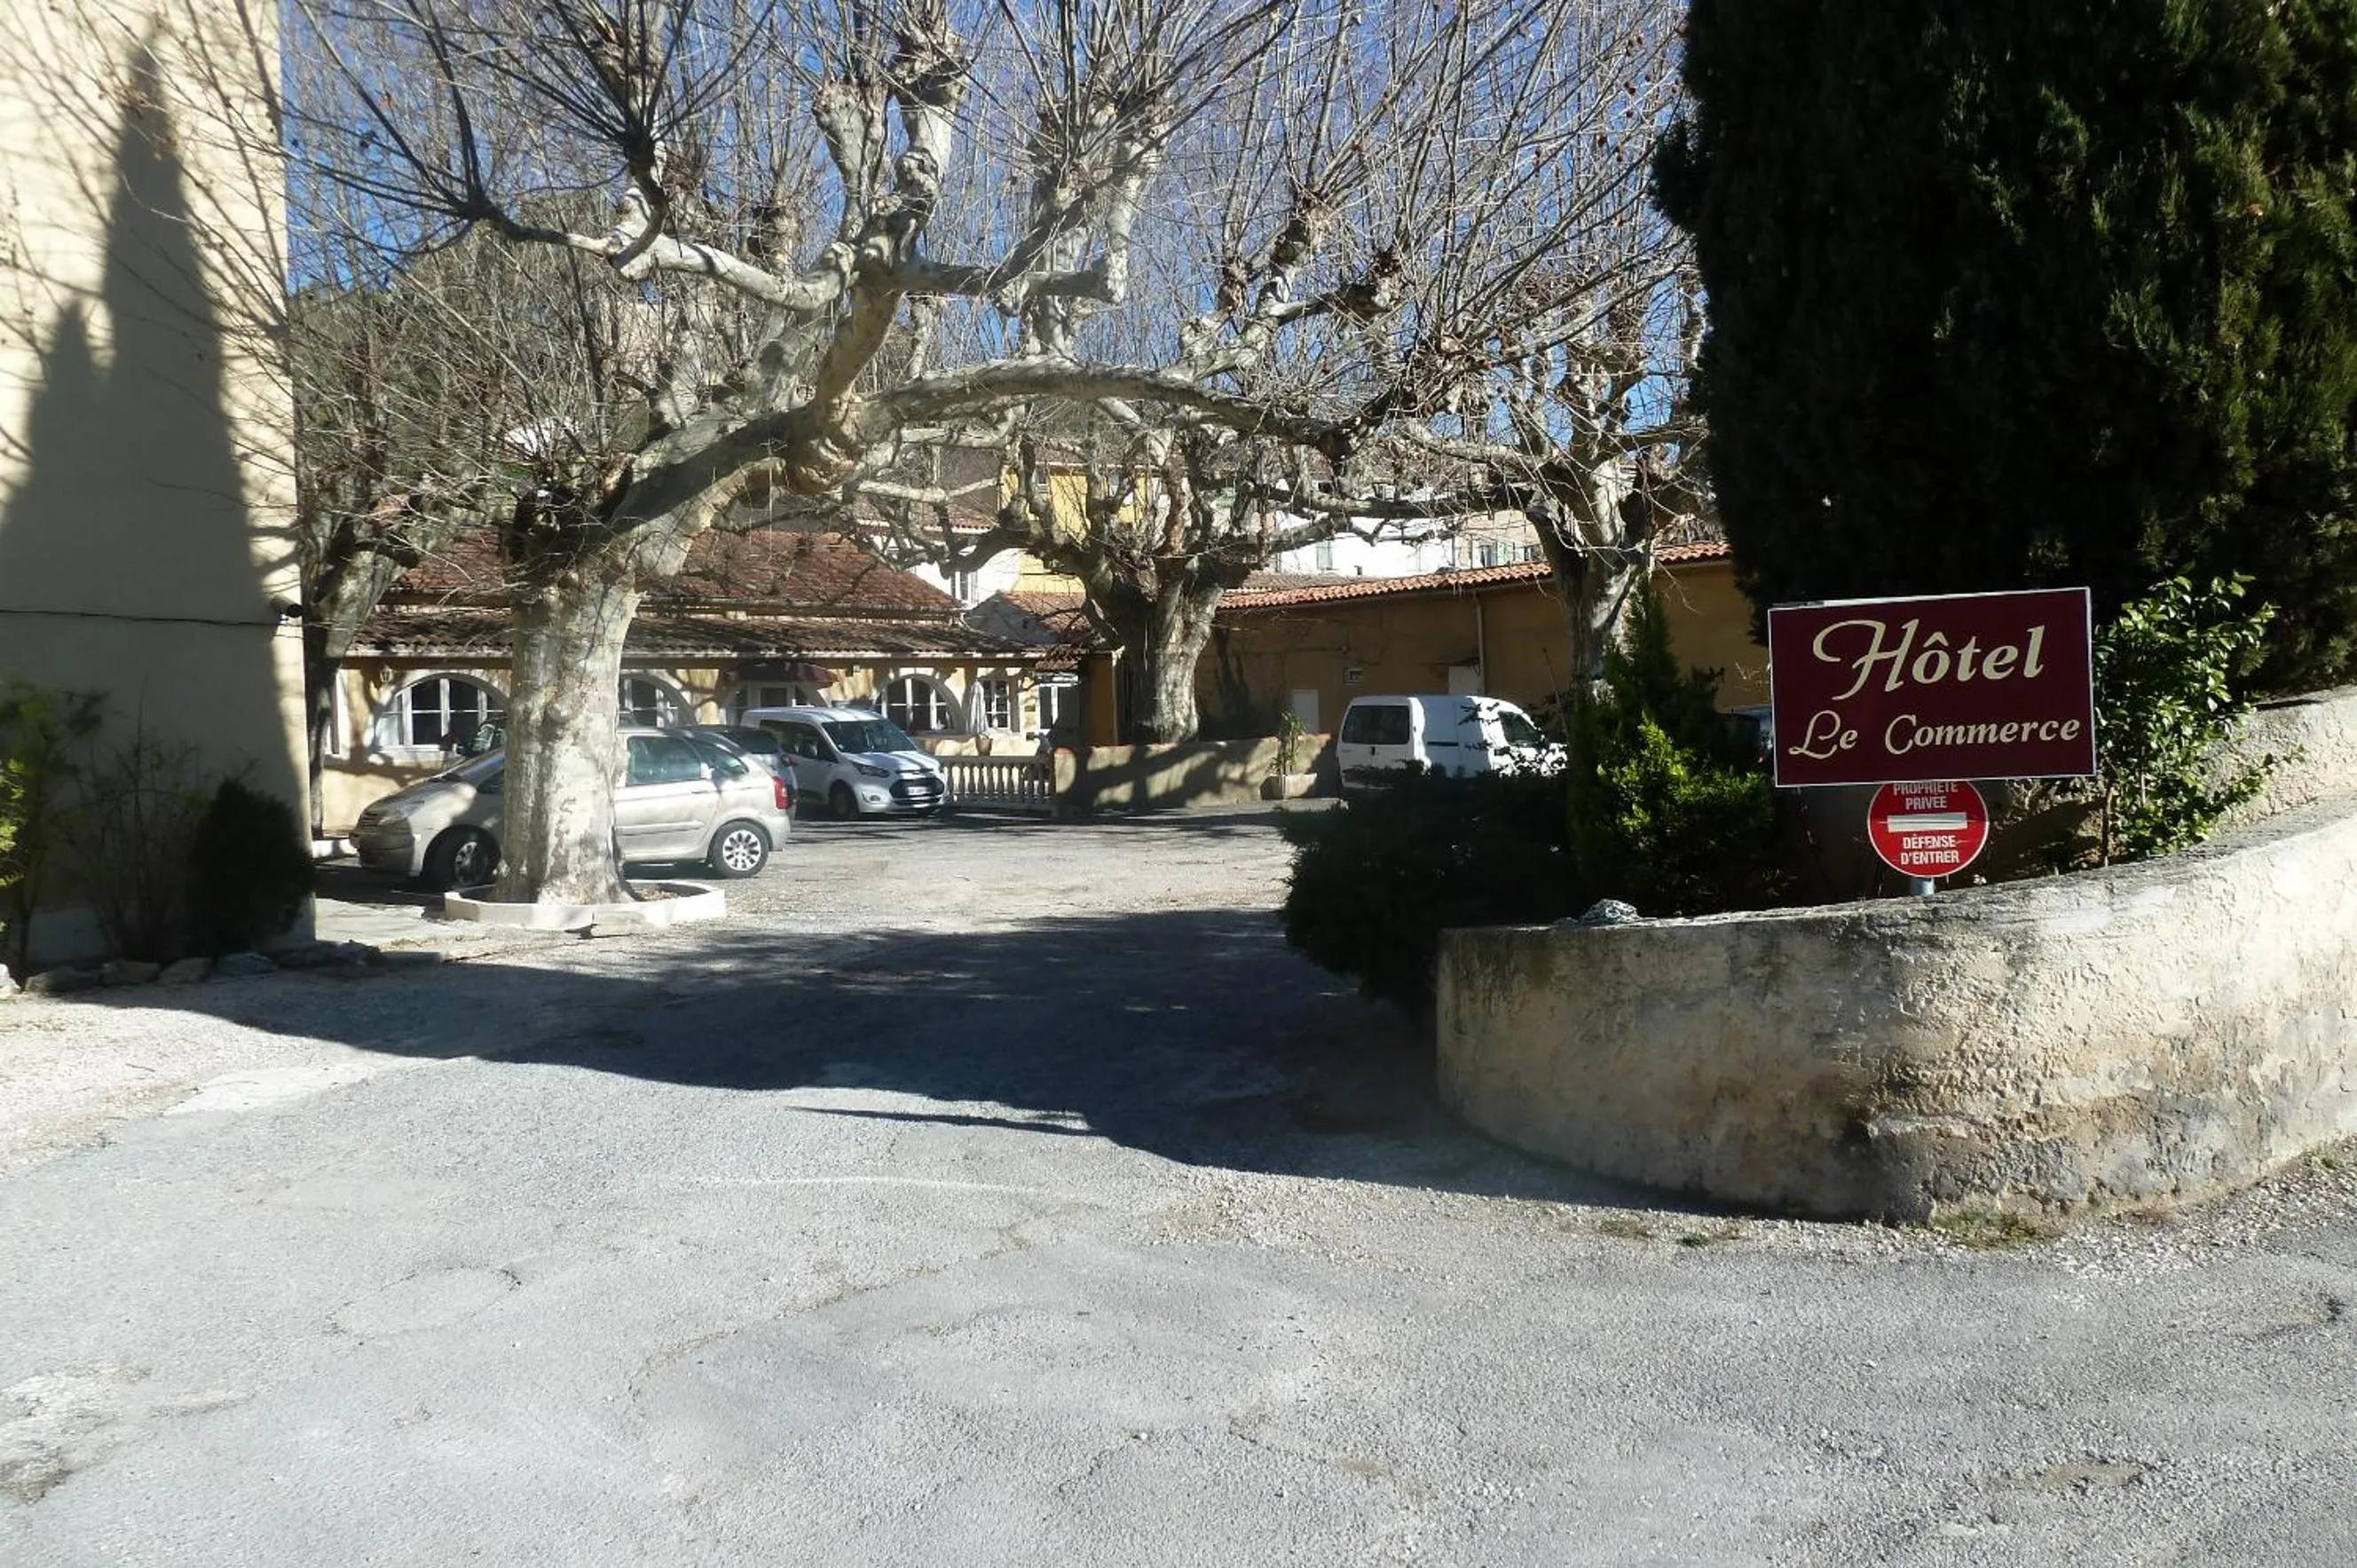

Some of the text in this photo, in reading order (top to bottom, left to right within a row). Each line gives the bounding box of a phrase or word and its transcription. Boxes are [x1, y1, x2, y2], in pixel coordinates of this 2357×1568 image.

[1812, 619, 2045, 700] Hôtel
[1788, 710, 2080, 760] Le Commerce
[1901, 850, 1959, 865] D'ENTRER
